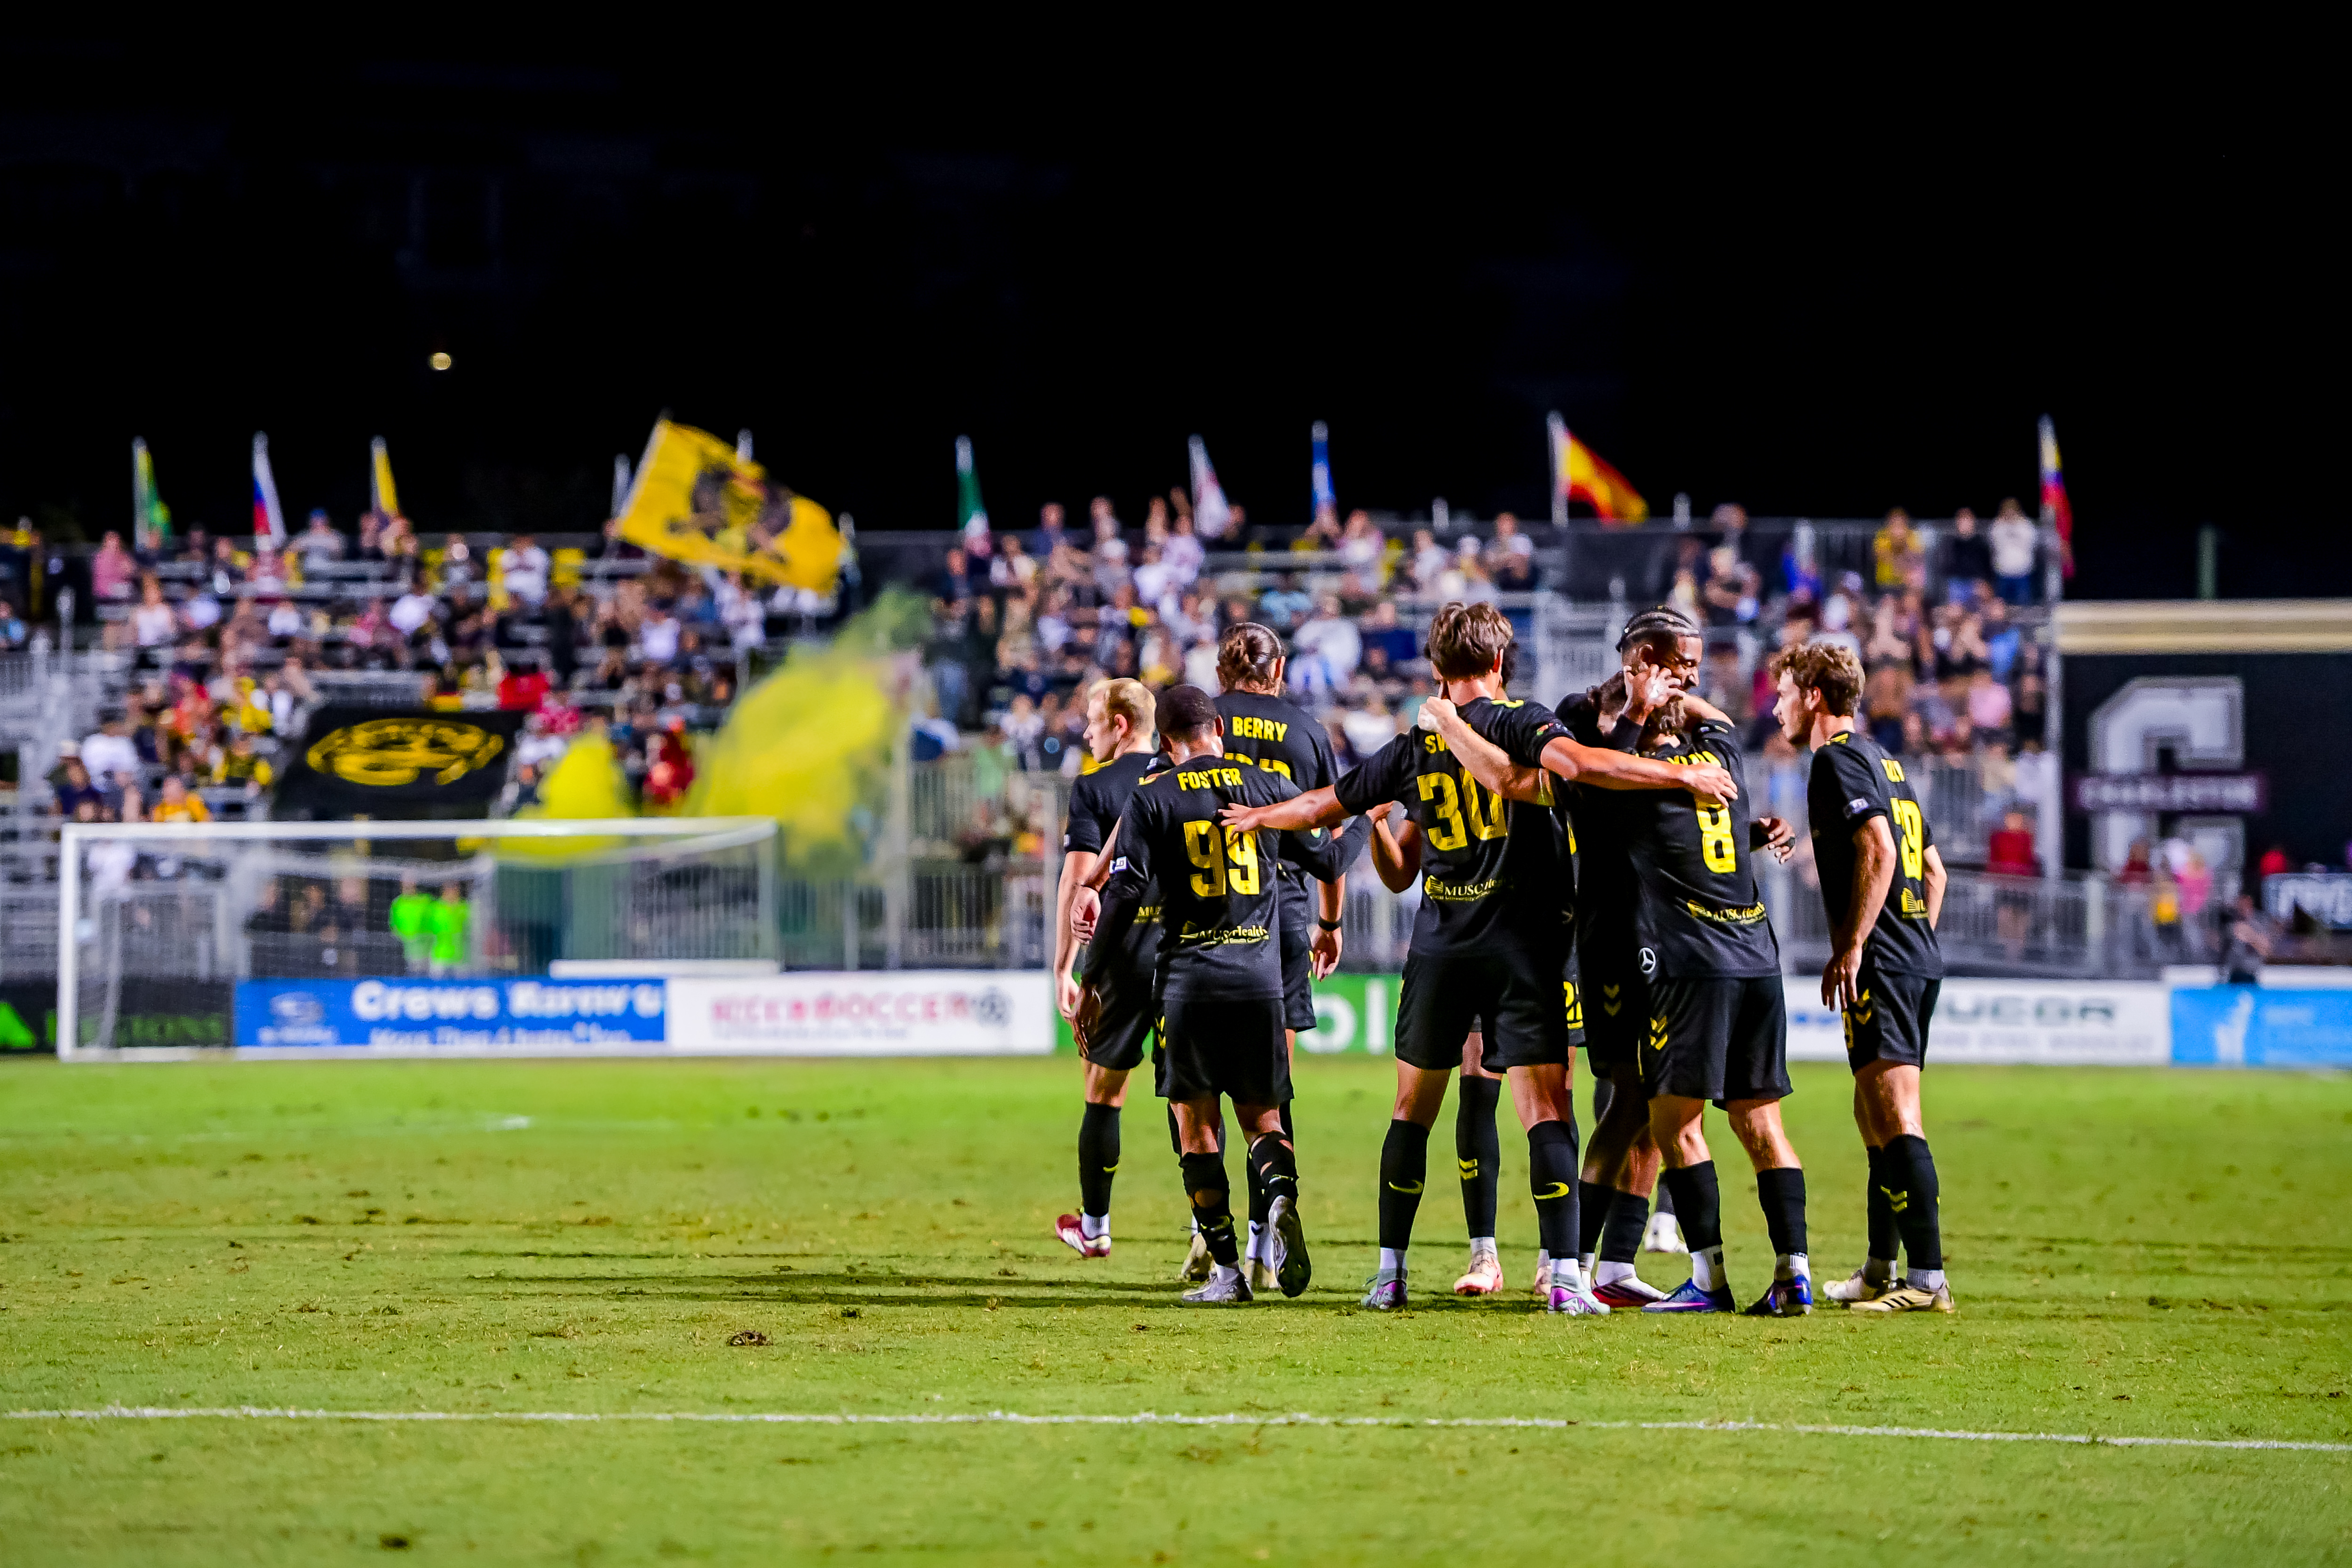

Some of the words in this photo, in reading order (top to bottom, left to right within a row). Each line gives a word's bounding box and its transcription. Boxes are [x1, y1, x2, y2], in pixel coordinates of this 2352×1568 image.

[1232, 716, 1288, 742] BERRY
[1177, 767, 1243, 791] FOSTER
[1416, 767, 1509, 852] 30
[1183, 820, 1260, 897] 99
[1695, 801, 1737, 874] 8
[1445, 883, 1484, 896] MUSC
